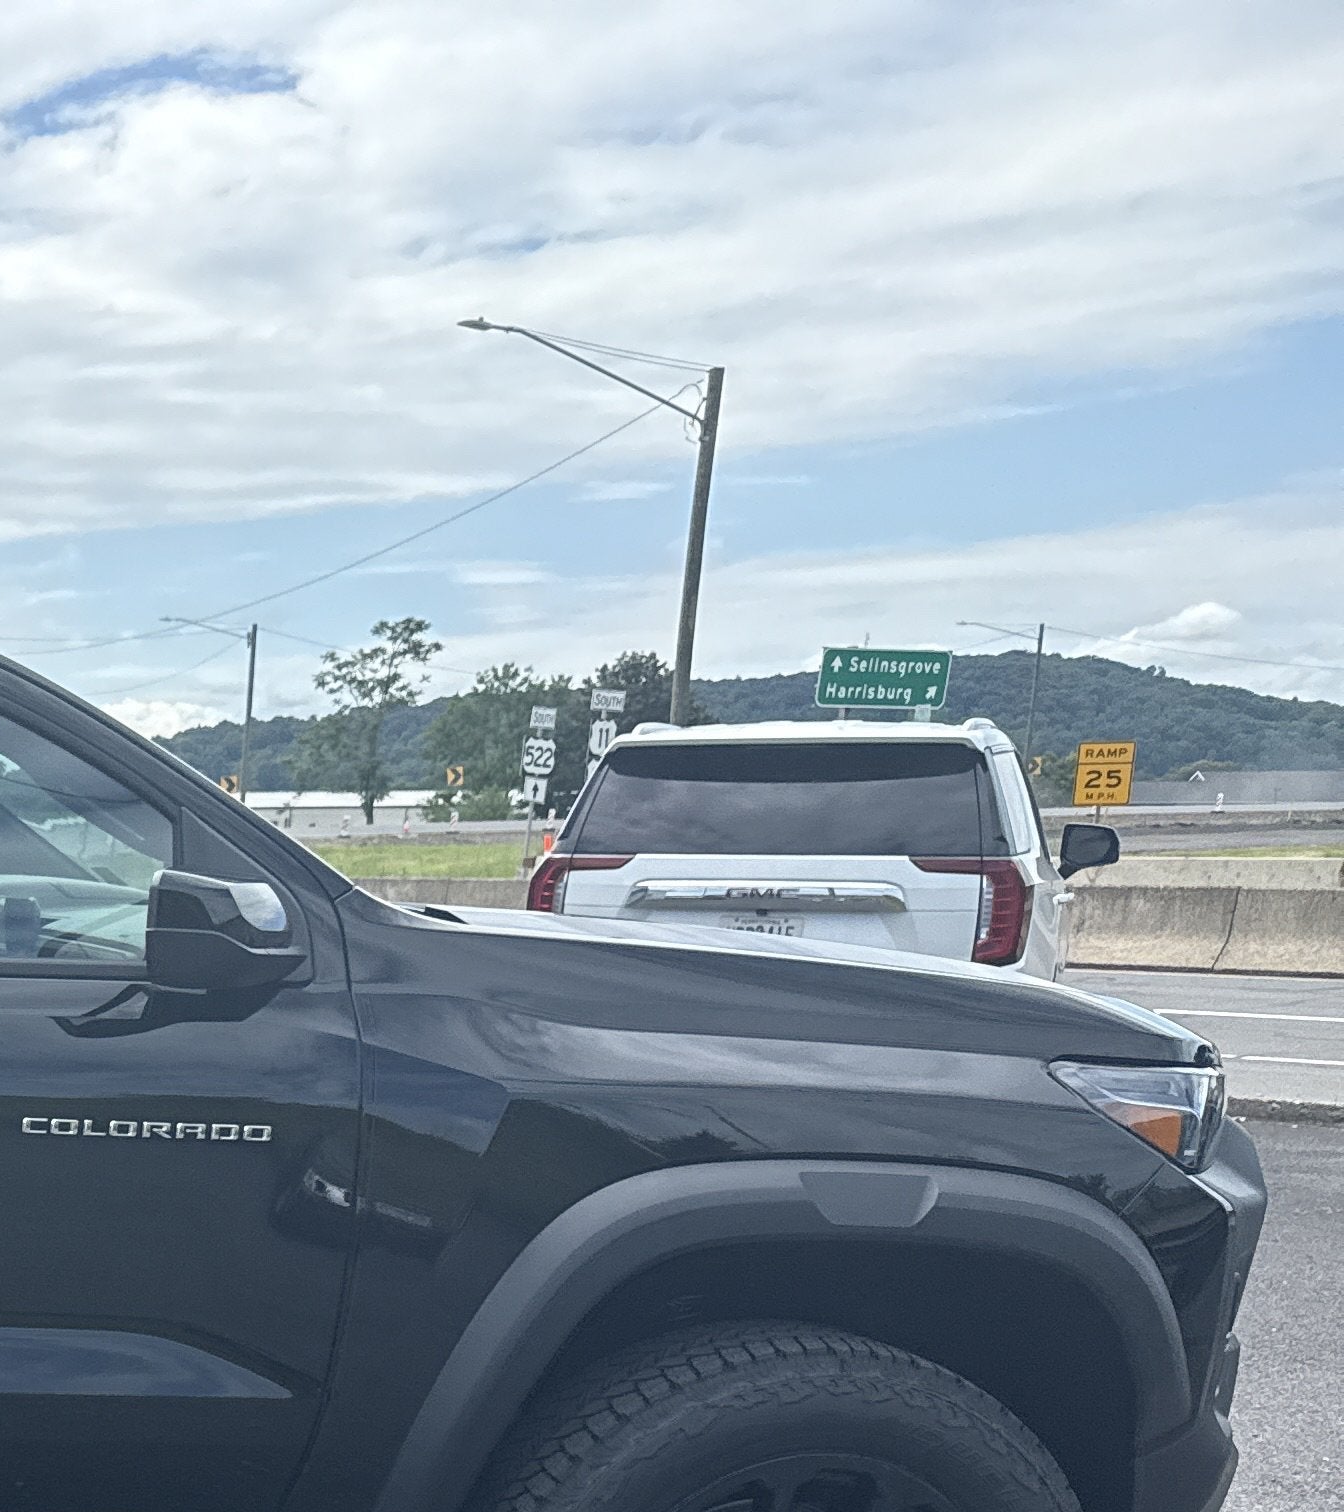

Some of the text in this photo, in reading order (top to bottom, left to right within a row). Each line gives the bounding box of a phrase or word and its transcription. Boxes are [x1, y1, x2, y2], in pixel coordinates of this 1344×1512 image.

[849, 656, 941, 678] Selinsgrove
[594, 693, 623, 706] SOUTH
[825, 682, 912, 705] Harrisburg
[598, 727, 610, 749] 11
[525, 745, 553, 769] 522
[1085, 747, 1128, 759] RAMP
[1084, 769, 1122, 789] 25
[21, 1116, 273, 1142] COLORADO
